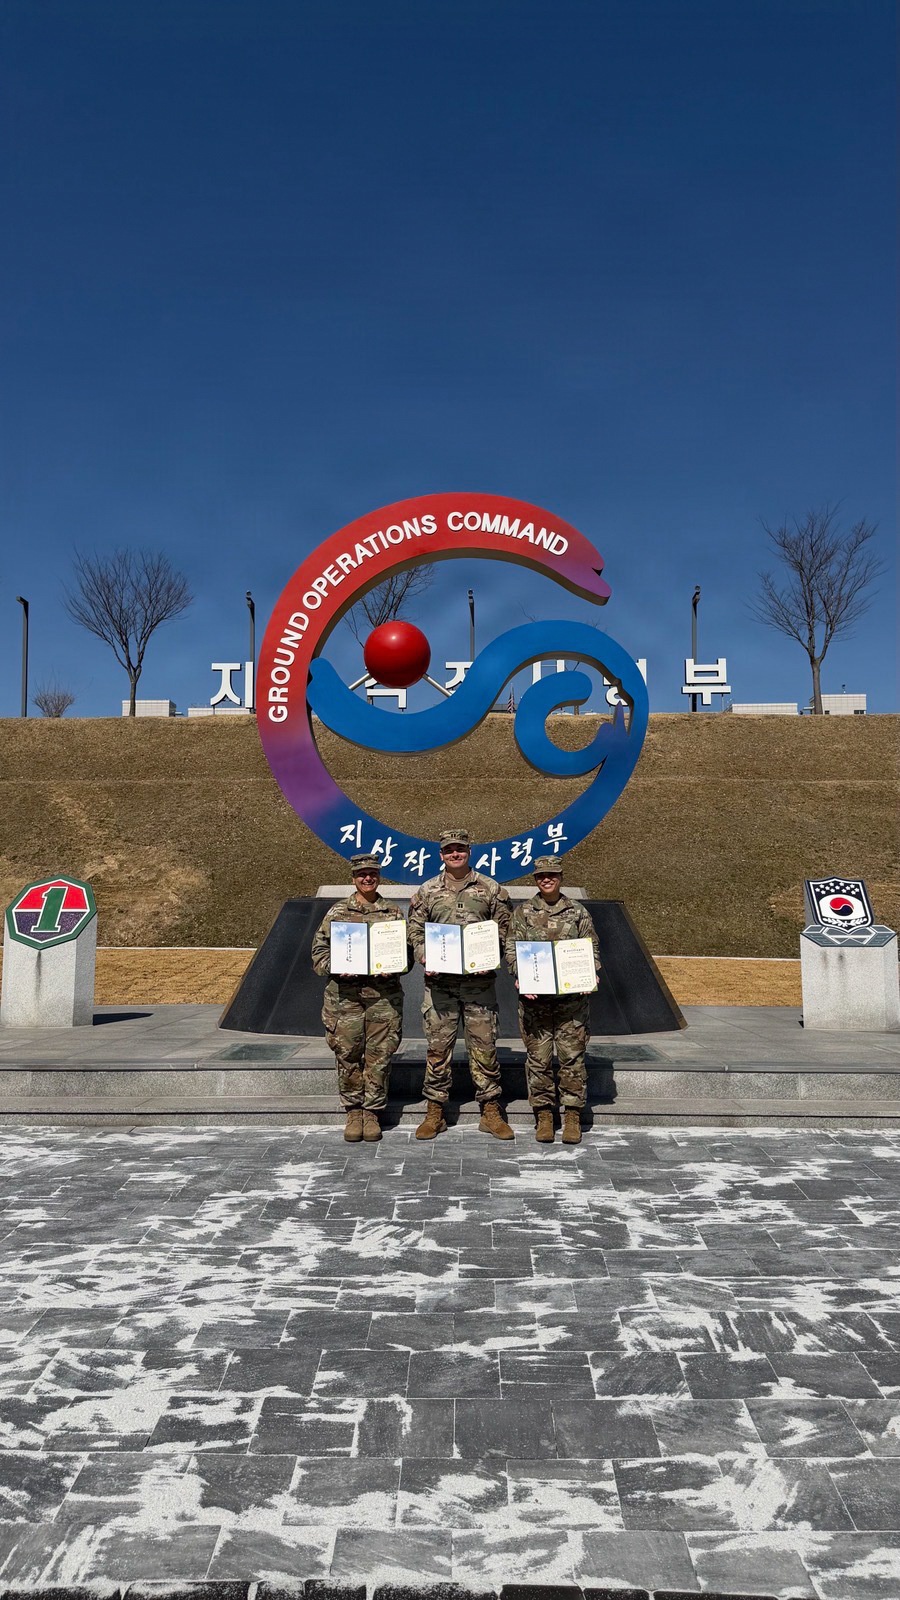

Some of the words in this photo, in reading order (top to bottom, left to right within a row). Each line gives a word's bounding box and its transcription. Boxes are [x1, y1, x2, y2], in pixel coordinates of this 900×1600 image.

[268, 611, 309, 723] GROUND
[302, 514, 438, 610] OPERATIONS
[447, 511, 569, 556] COMMAND
[340, 819, 568, 877] 지상작사령부
[30, 886, 69, 933] 1
